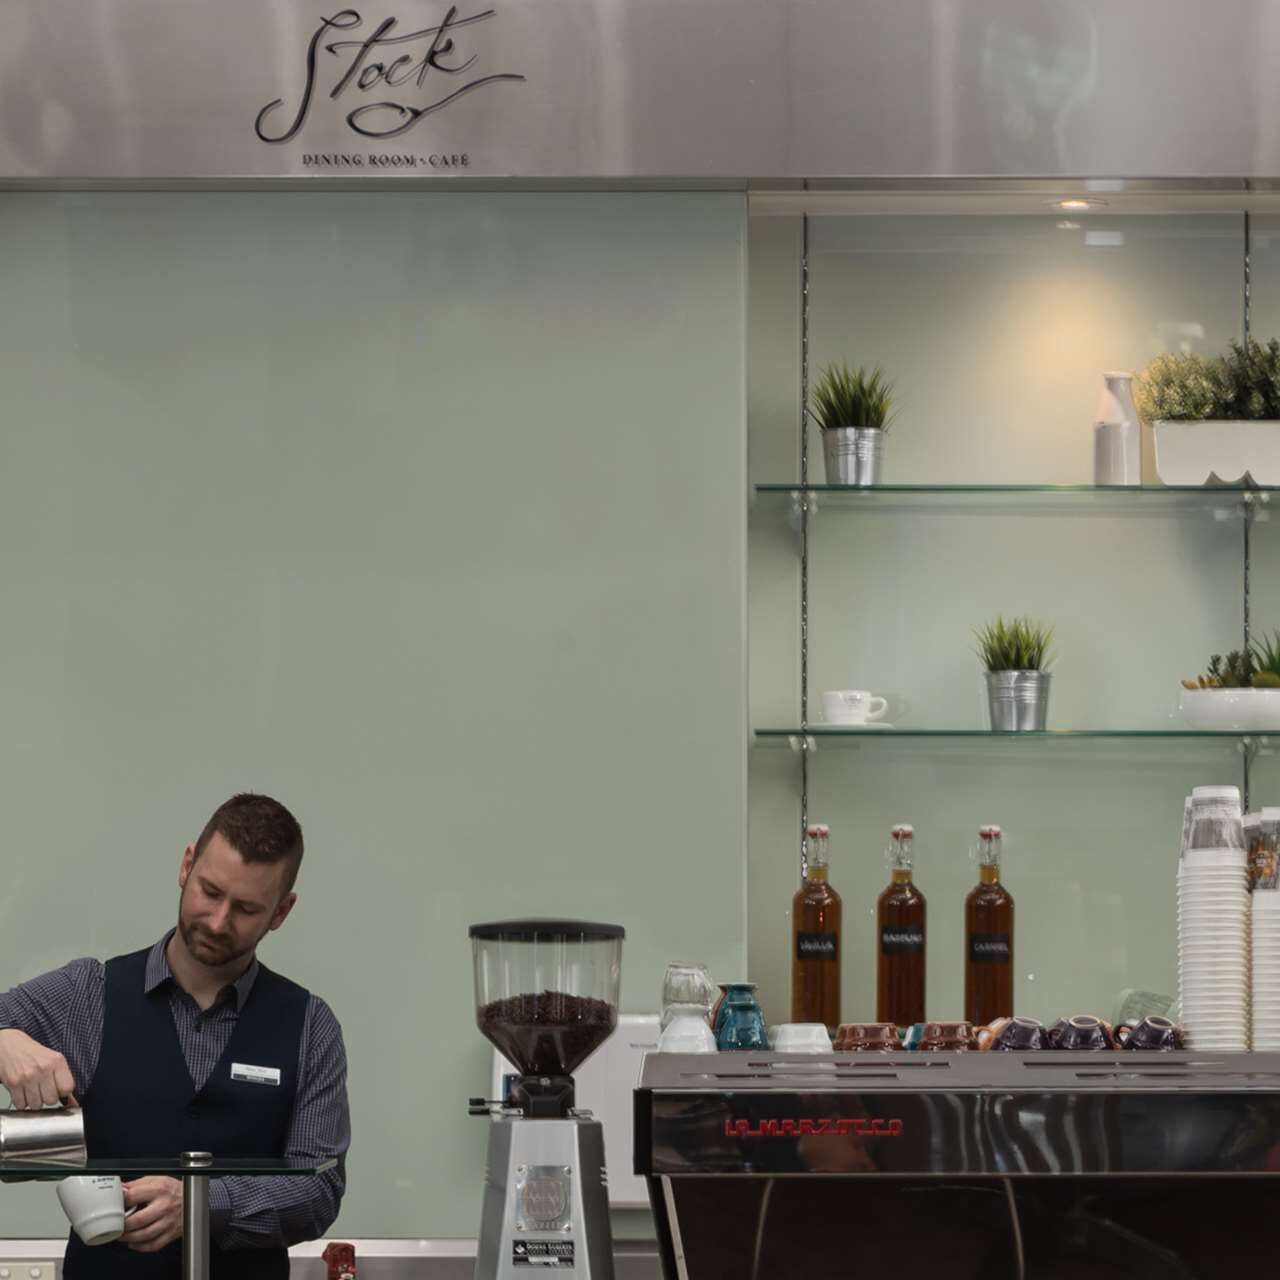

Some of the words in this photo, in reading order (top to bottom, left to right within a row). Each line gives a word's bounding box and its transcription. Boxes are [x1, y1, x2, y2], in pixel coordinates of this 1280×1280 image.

[255, 5, 496, 144] Stock
[302, 153, 363, 168] DINING
[368, 153, 417, 168] ROOM
[428, 152, 471, 168] CAFÉ
